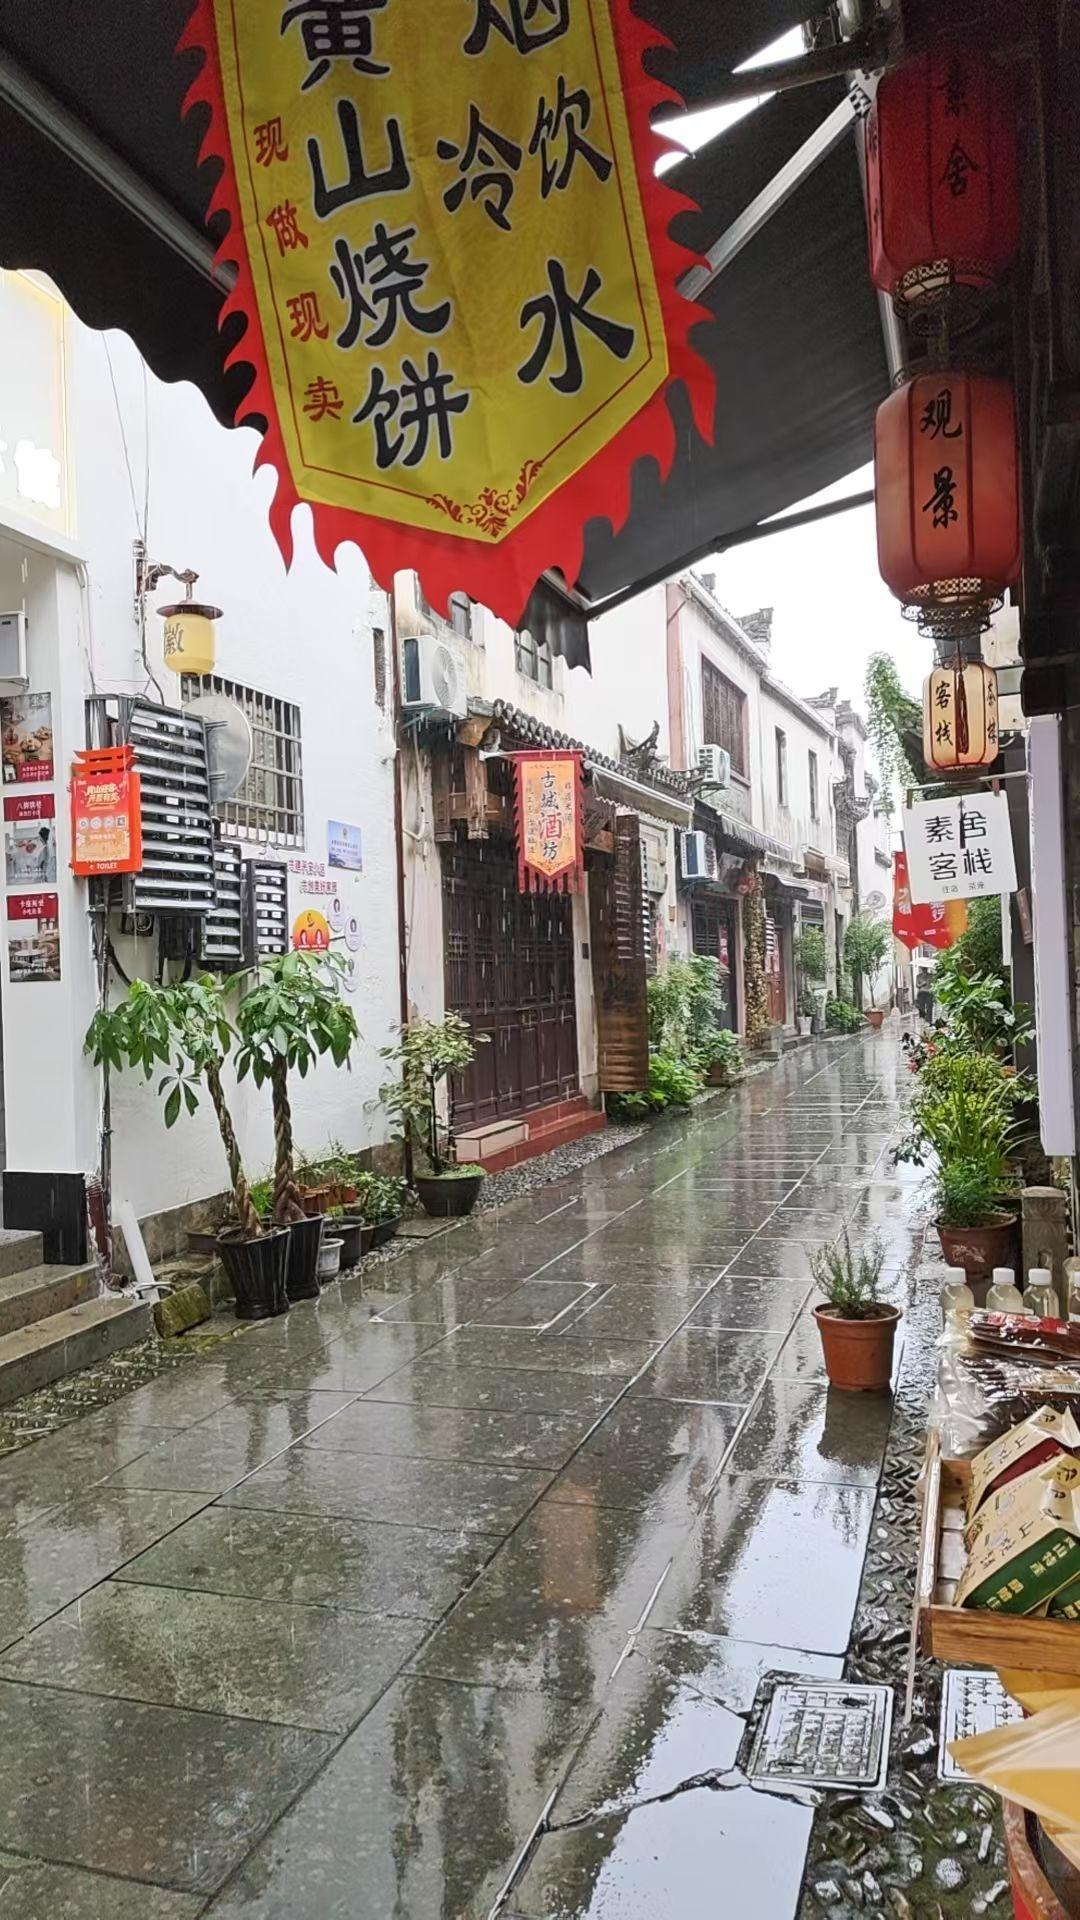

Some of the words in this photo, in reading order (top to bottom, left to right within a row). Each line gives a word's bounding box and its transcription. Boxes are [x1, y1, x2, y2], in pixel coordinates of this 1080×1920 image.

[436, 75, 613, 231] 冷饮
[254, 117, 343, 422] 现做现卖
[280, 0, 470, 470] 黄山烧饼
[517, 260, 634, 393] 水
[920, 389, 963, 529] 观景
[935, 681, 953, 746] 客栈
[96, 862, 118, 870] TOILET
[539, 771, 562, 860] 古城酒坊
[924, 811, 987, 843] 素舍
[929, 848, 993, 881] 客栈
